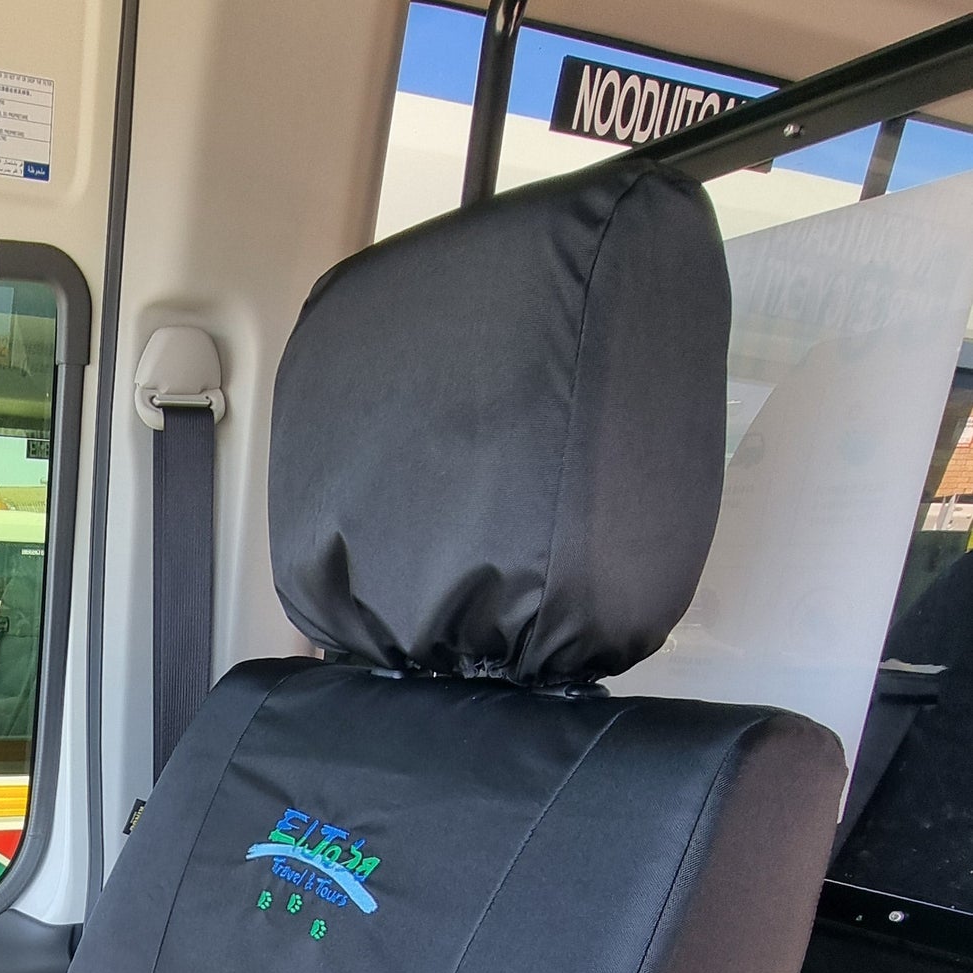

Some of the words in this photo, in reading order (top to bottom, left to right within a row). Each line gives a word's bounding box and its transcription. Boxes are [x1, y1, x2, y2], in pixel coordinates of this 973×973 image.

[571, 64, 747, 143] NOODUIT
[272, 856, 309, 886] Travel
[303, 871, 316, 891] &
[315, 877, 349, 907] Tours
